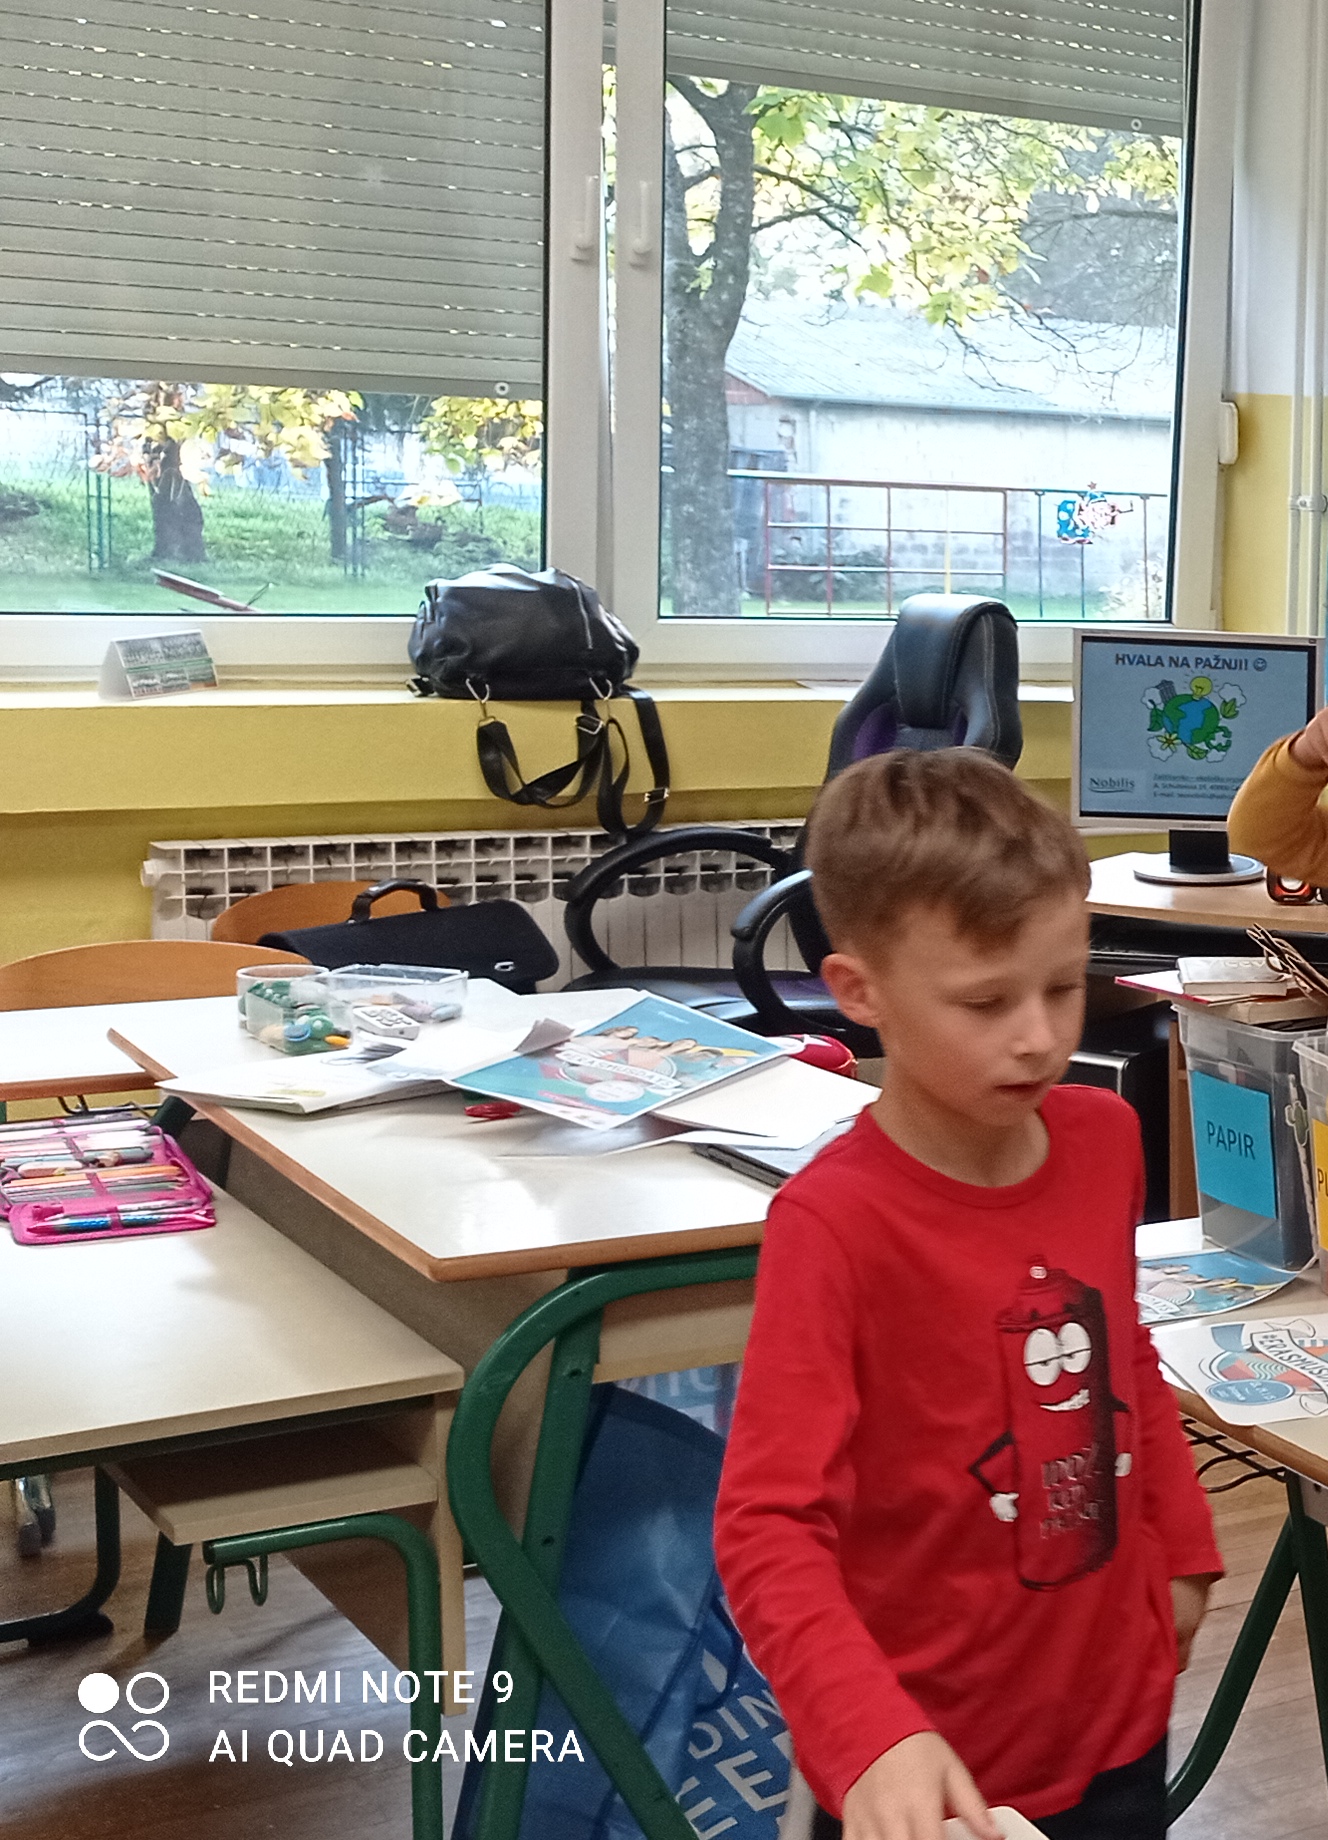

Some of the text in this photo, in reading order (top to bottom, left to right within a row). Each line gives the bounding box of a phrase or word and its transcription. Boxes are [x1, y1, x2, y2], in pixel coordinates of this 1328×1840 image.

[1115, 653, 1248, 671] HVALA NA PAŽNJI!
[1089, 777, 1135, 788] Nobilis
[1206, 1122, 1256, 1161] PAPIR
